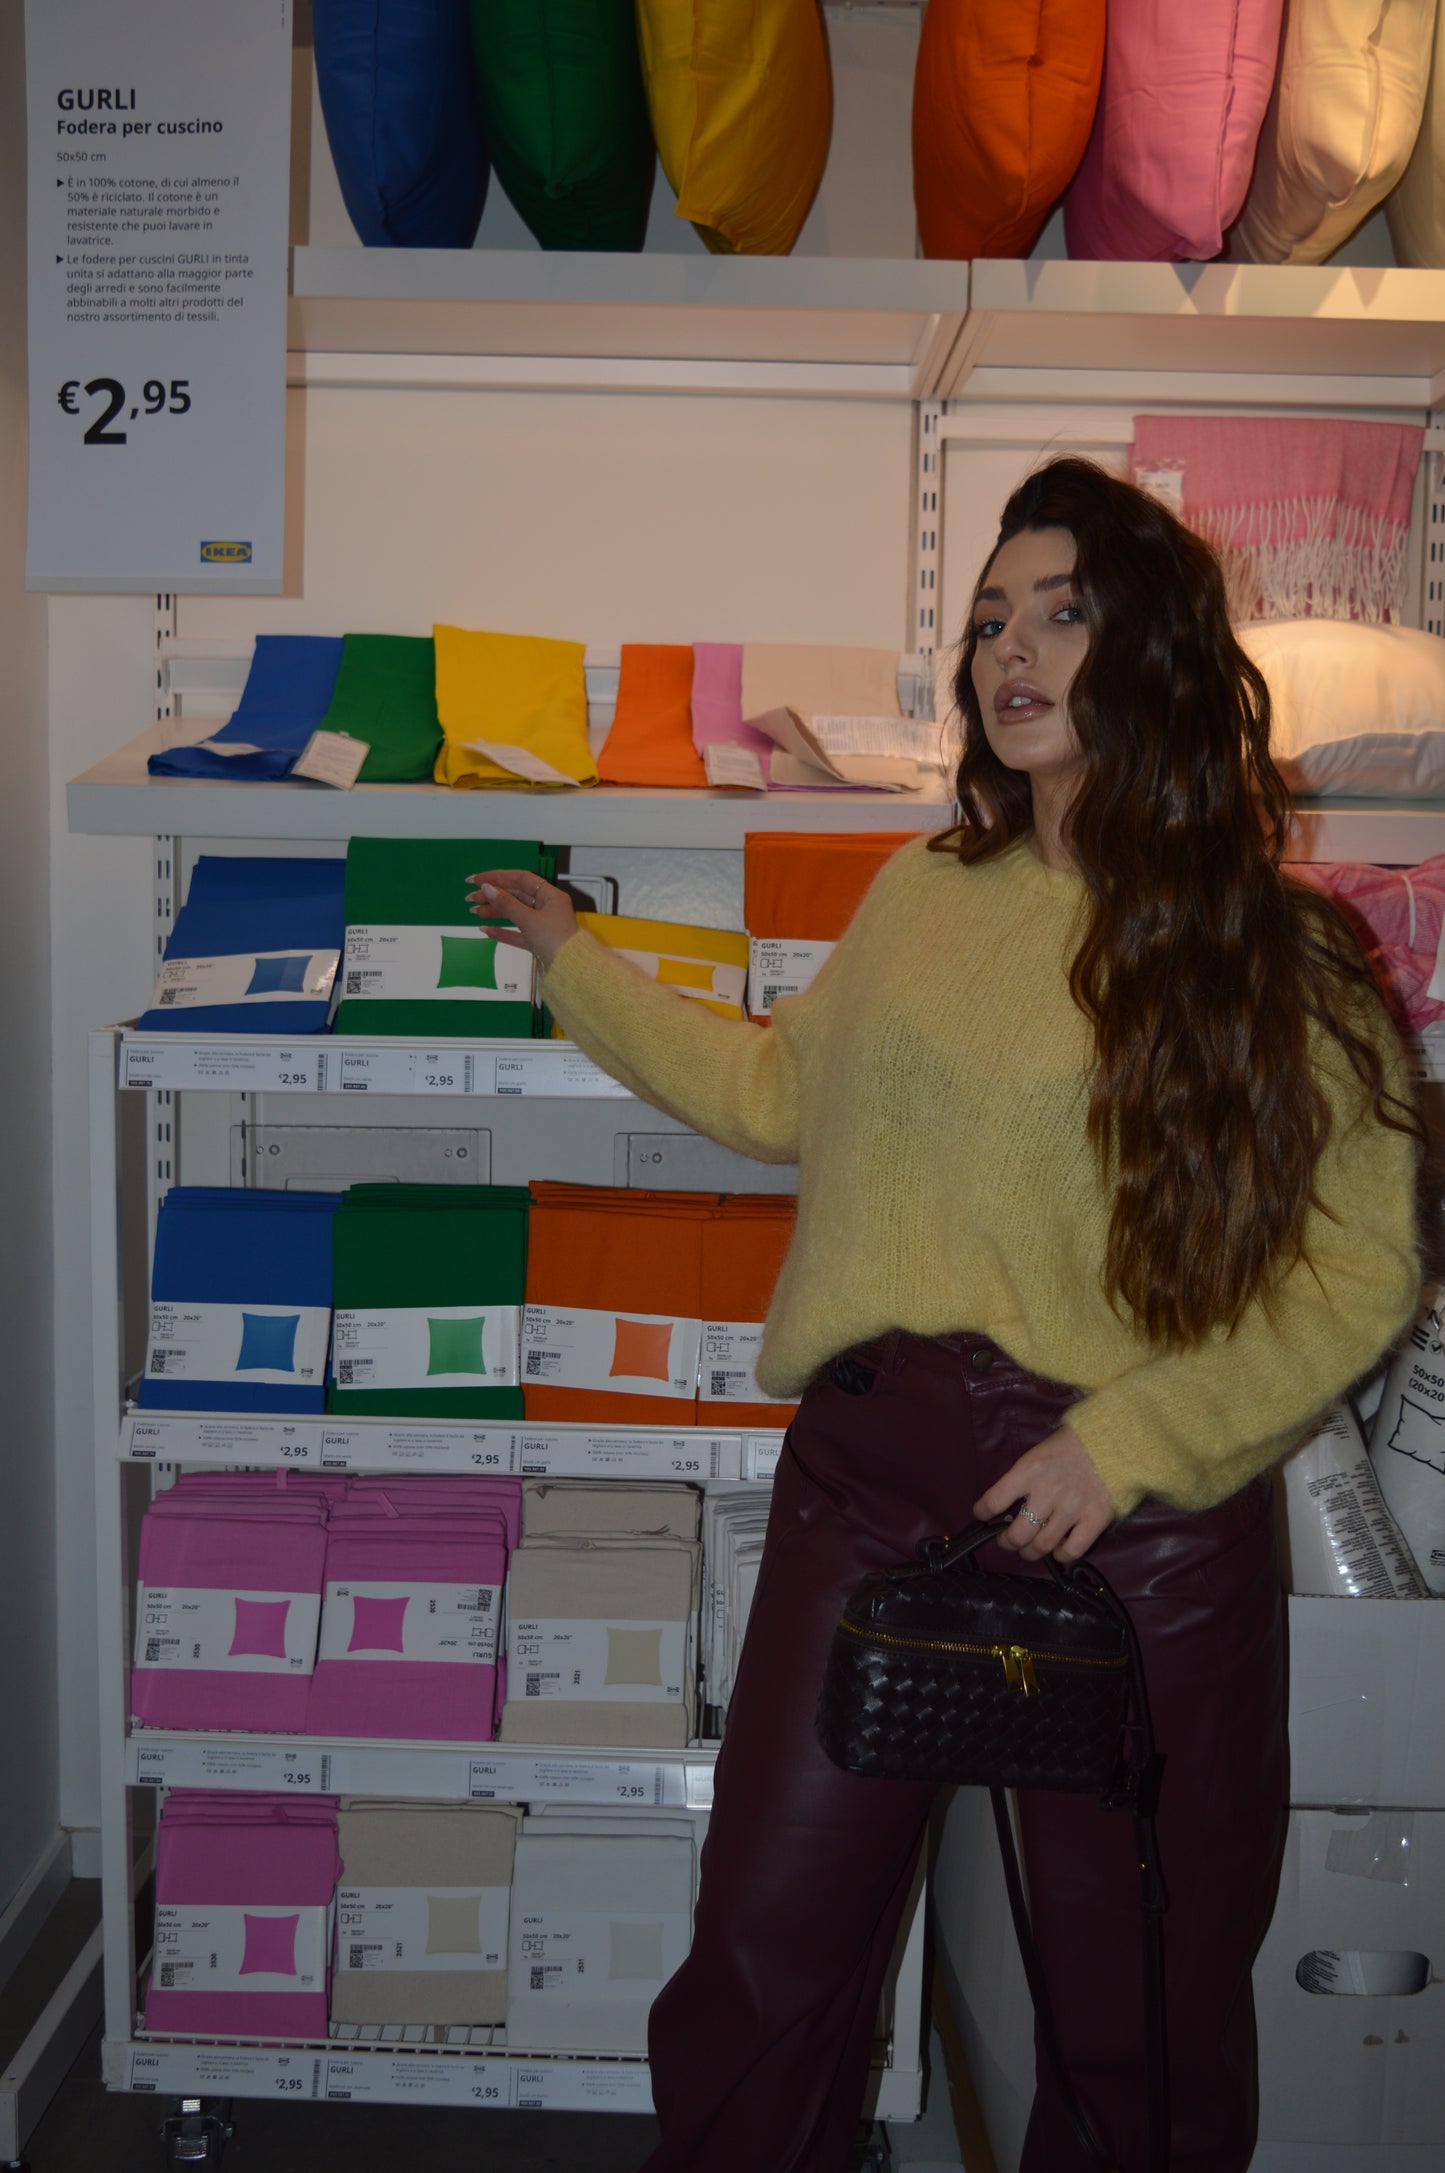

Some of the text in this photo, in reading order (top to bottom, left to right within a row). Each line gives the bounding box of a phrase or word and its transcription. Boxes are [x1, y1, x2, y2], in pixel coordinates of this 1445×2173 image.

[57, 89, 136, 110] GURLI
[57, 119, 223, 138] Fodera per cuscino
[57, 152, 88, 161] 50x50
[68, 176, 239, 189] È in 100% cotone, di cui almeno il
[68, 191, 218, 202] 50% è riciclato. Il cotone è un
[68, 206, 116, 216] materiale
[120, 206, 163, 216] naturale
[167, 206, 210, 216] morbido
[68, 219, 212, 232] resistente che puoi lavare in
[68, 235, 113, 245] lavatrice.
[68, 254, 248, 266] Le fodere per cuscini GURLI in tinta
[68, 268, 253, 280] unita si adattano alla maggior parte
[68, 283, 92, 295] degli
[96, 283, 126, 293] arredi
[166, 282, 220, 292] facilmente
[68, 297, 117, 307] abbinabili
[129, 297, 155, 307] molti
[159, 297, 179, 307] altri
[182, 297, 224, 309] prodotti
[227, 296, 243, 306] del
[68, 311, 218, 322] nostro assortimento di tessili.
[58, 378, 191, 444] €2,95
[278, 1074, 306, 1083] €2,95
[426, 1076, 453, 1086] €2,95
[1412, 1365, 1444, 1387] 50x50
[1409, 1378, 1444, 1402] (20x20
[281, 1447, 308, 1456] €2,95
[759, 1448, 779, 1456] GURL
[472, 1454, 499, 1464] €2,95
[672, 1461, 699, 1471] €2,95
[284, 1774, 311, 1783] €2,95
[617, 1786, 644, 1797] €2,95
[331, 2066, 353, 2074] GURLI
[276, 2080, 302, 2090] €2,95
[472, 2087, 498, 2098] €2,95
